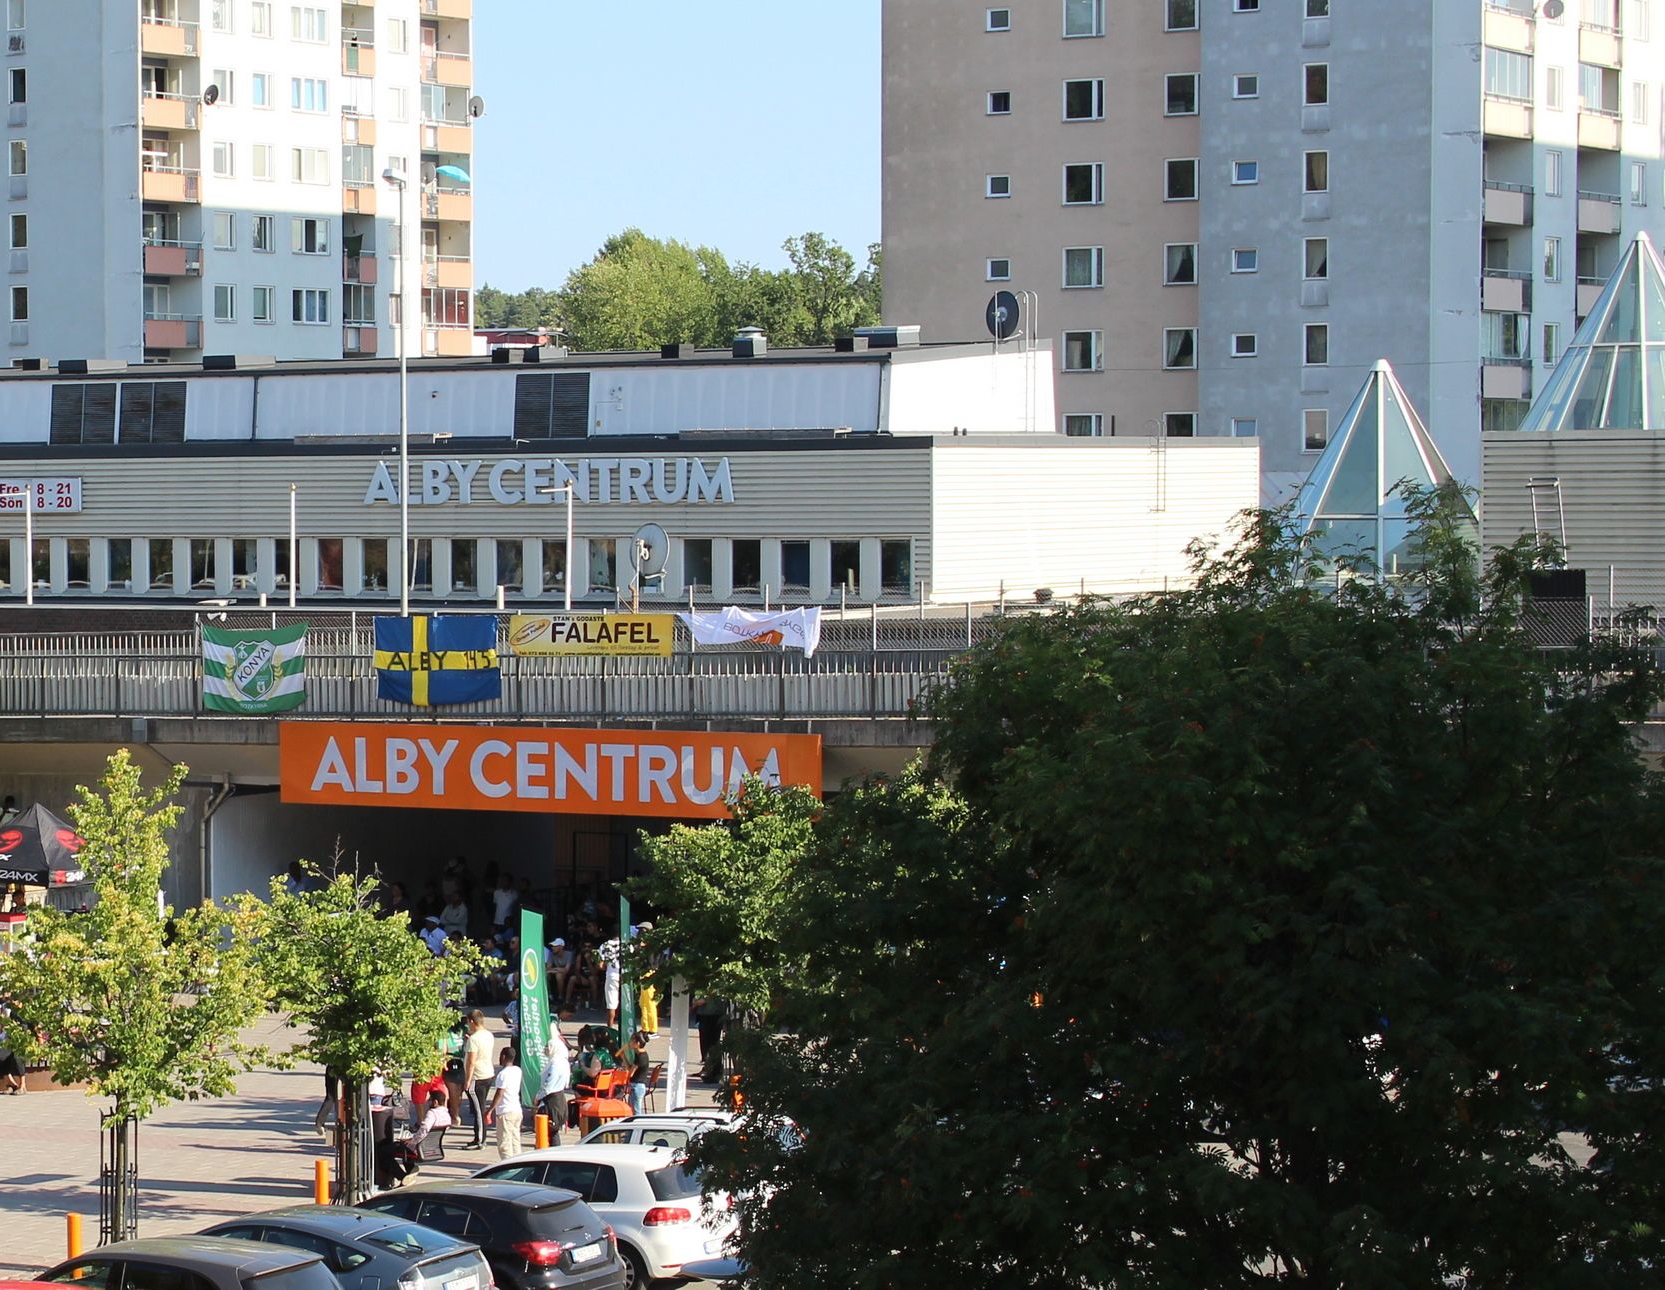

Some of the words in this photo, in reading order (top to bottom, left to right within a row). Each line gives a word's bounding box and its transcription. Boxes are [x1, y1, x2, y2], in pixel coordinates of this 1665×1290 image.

[0, 483, 20, 495] Fre
[37, 483, 45, 495] 8
[56, 483, 72, 495] 21
[363, 458, 483, 506] ALBY
[488, 457, 735, 506] CENTRUM
[0, 496, 23, 509] Sön
[37, 497, 45, 509] 8
[56, 497, 73, 509] 20
[551, 622, 660, 644] FALAFEL
[237, 647, 270, 682] KONYA
[387, 651, 447, 671] ALBY
[310, 735, 459, 795] ALBY
[469, 739, 782, 806] CENTRUM
